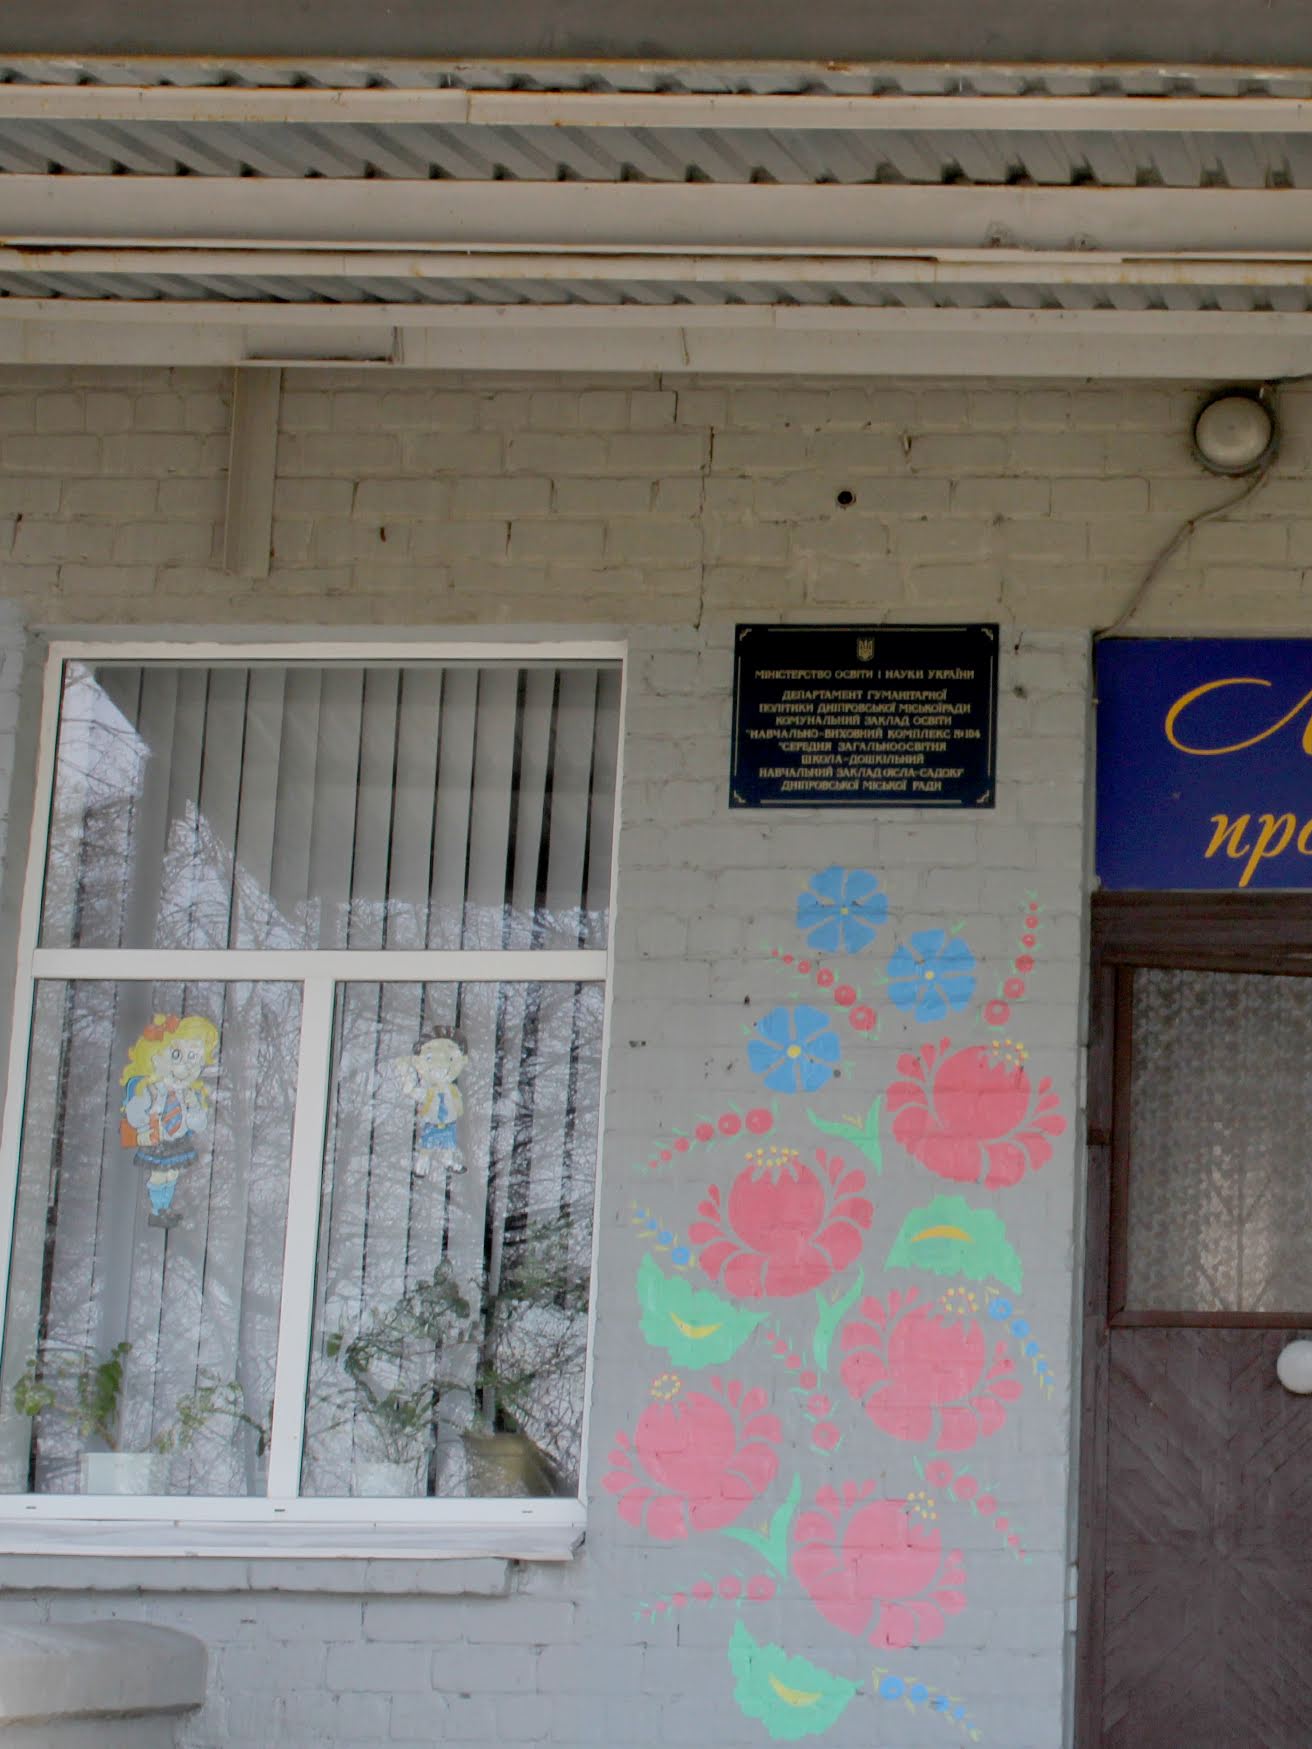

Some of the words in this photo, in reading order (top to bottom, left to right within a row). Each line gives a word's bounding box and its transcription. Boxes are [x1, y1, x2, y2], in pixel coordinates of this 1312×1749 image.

[755, 669, 831, 679] МІНІСТЕРСТВО
[835, 670, 873, 679] ОСВІТИ
[885, 670, 923, 679] НАУКИ
[928, 668, 974, 680] УКРАЇНИ
[782, 690, 863, 701] ДЕПАРТАМЕНТ
[867, 688, 947, 700] ГУМАНІТАРНОЇ
[759, 704, 813, 713] ПОЛІТИКИ
[817, 703, 896, 713] ДНІПРОВСЬКОЇ
[776, 716, 860, 725] КОМУНАЛЬНИЙ
[865, 716, 909, 726] ЗАКЛАД
[913, 716, 952, 725] ОСВІТИ
[888, 729, 951, 739] КОМПЛЕКС
[838, 743, 946, 752] ЗАГАЛЬНООСВІТНЯ
[801, 754, 924, 765] ШКОЛА-ДОШКІЛЬНИЙ
[759, 767, 833, 778] НАВЧАЛЬНИЙ
[836, 768, 881, 779] ЗАКЛАД
[781, 780, 859, 792] ДНІПРОВСЬКОЇ
[863, 780, 907, 791] МІСЬКОЇ
[913, 781, 941, 792] РАДИ
